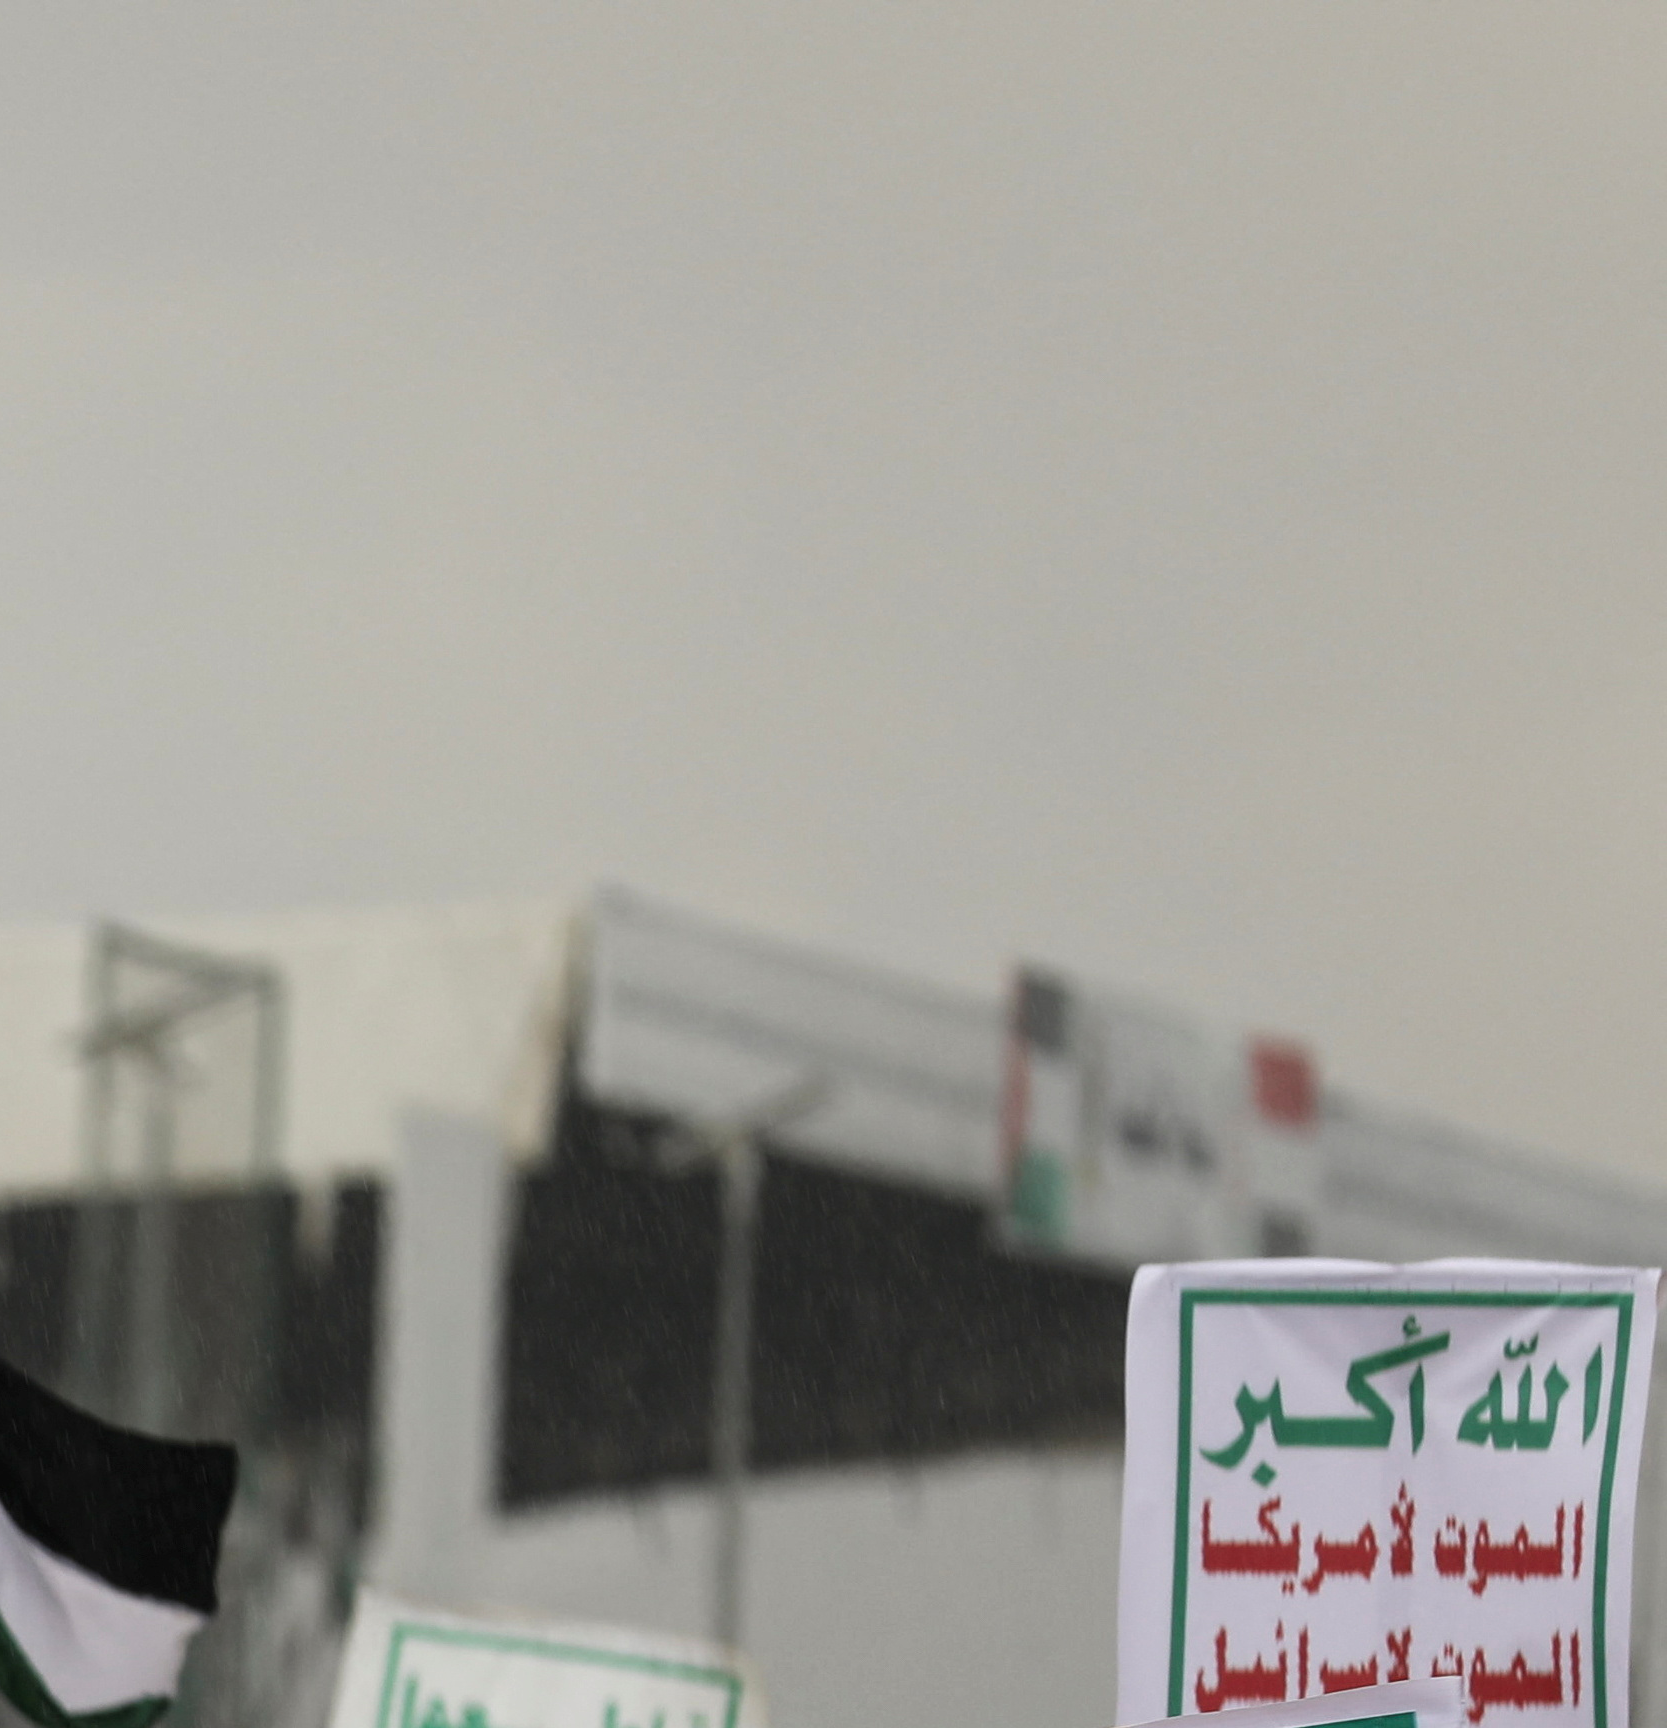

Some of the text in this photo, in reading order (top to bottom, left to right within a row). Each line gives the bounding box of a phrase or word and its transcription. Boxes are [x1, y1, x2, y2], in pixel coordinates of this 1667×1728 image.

[1203, 1316, 1604, 1487] الله أكبر
[1200, 1485, 1585, 1597] الموت لأمريكا
